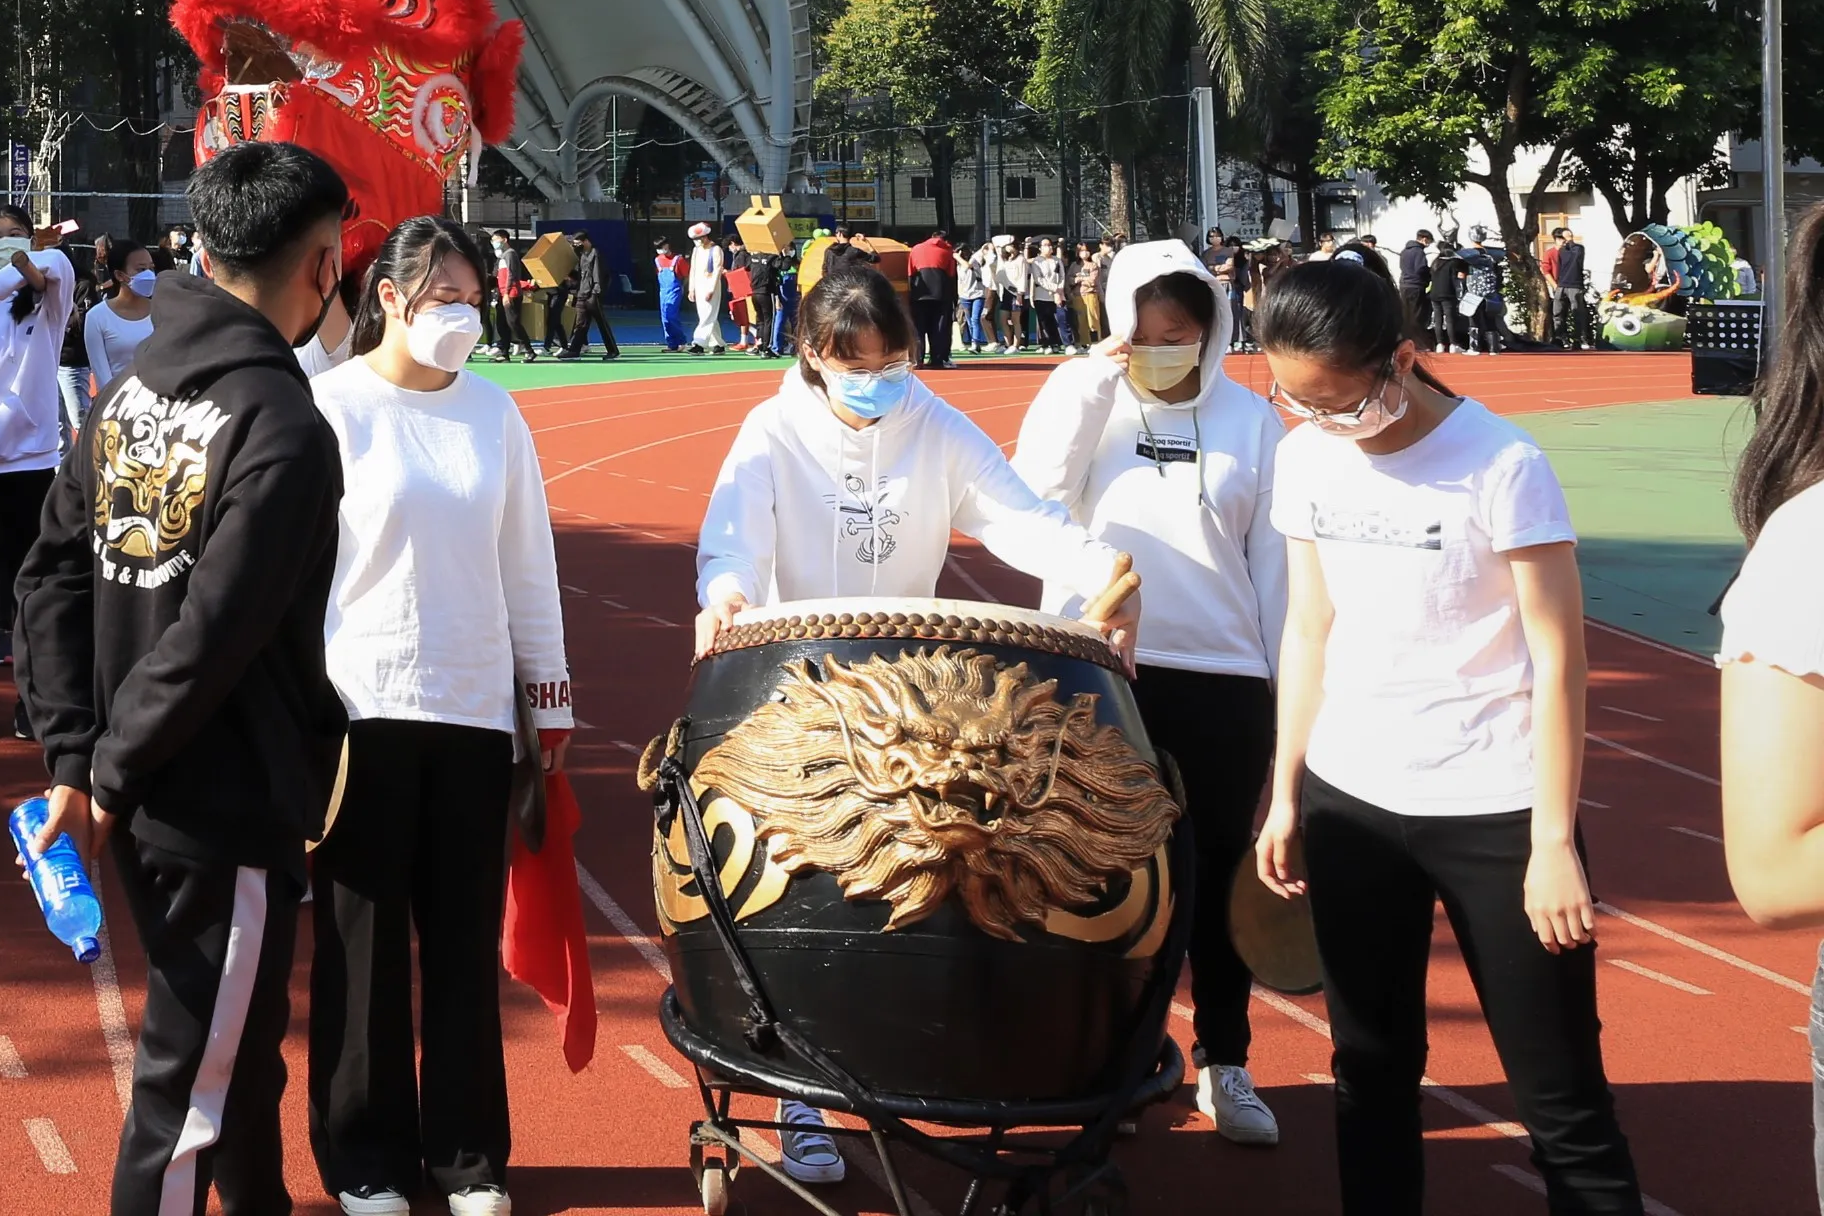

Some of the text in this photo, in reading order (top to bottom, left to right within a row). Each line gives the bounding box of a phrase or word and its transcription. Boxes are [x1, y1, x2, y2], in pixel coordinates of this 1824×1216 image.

[1167, 438, 1192, 448] sportif
[1165, 451, 1191, 460] sportif
[526, 680, 570, 709] SHA
